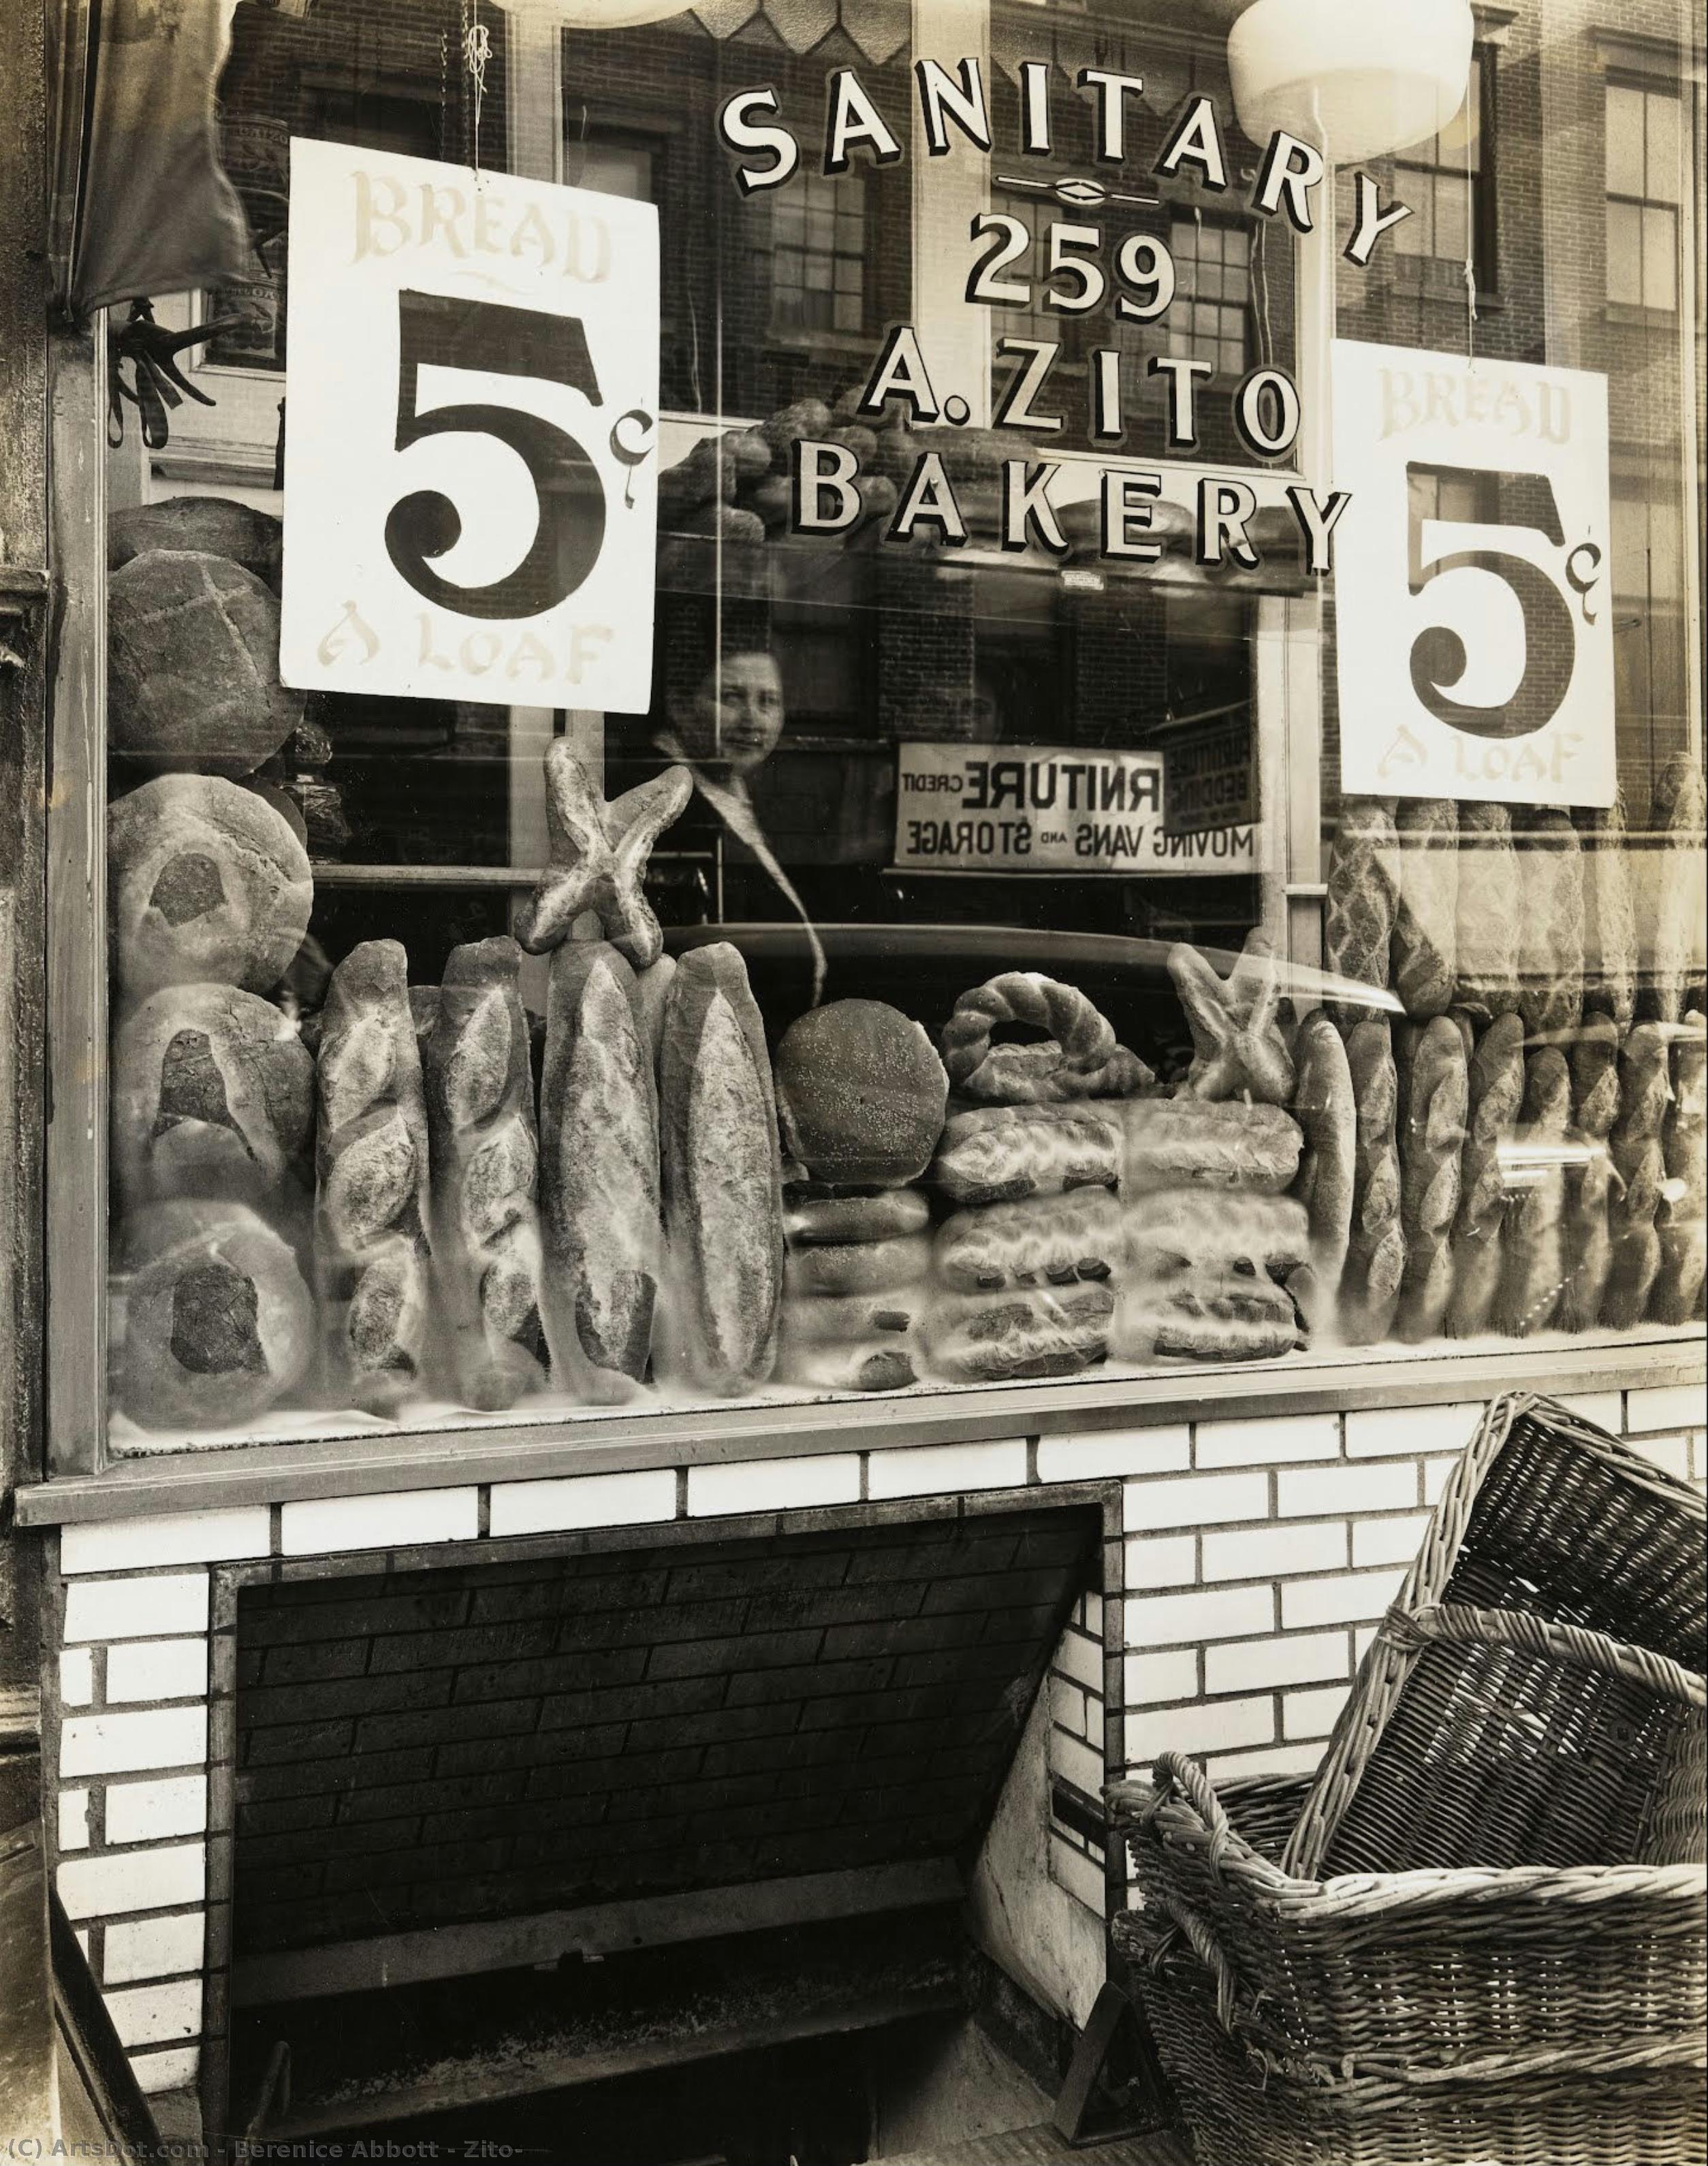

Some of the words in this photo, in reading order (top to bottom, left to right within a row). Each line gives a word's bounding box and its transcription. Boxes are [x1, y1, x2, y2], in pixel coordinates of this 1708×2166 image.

[719, 57, 1414, 267] SANITARY
[348, 170, 612, 284] BREAD
[965, 213, 1175, 323] 259
[1377, 368, 1572, 445] BREAD
[791, 437, 1351, 576] BAKERY
[317, 599, 381, 667] A
[413, 611, 614, 685] LOAF
[1376, 724, 1429, 780] A
[1451, 730, 1584, 784] LOAF
